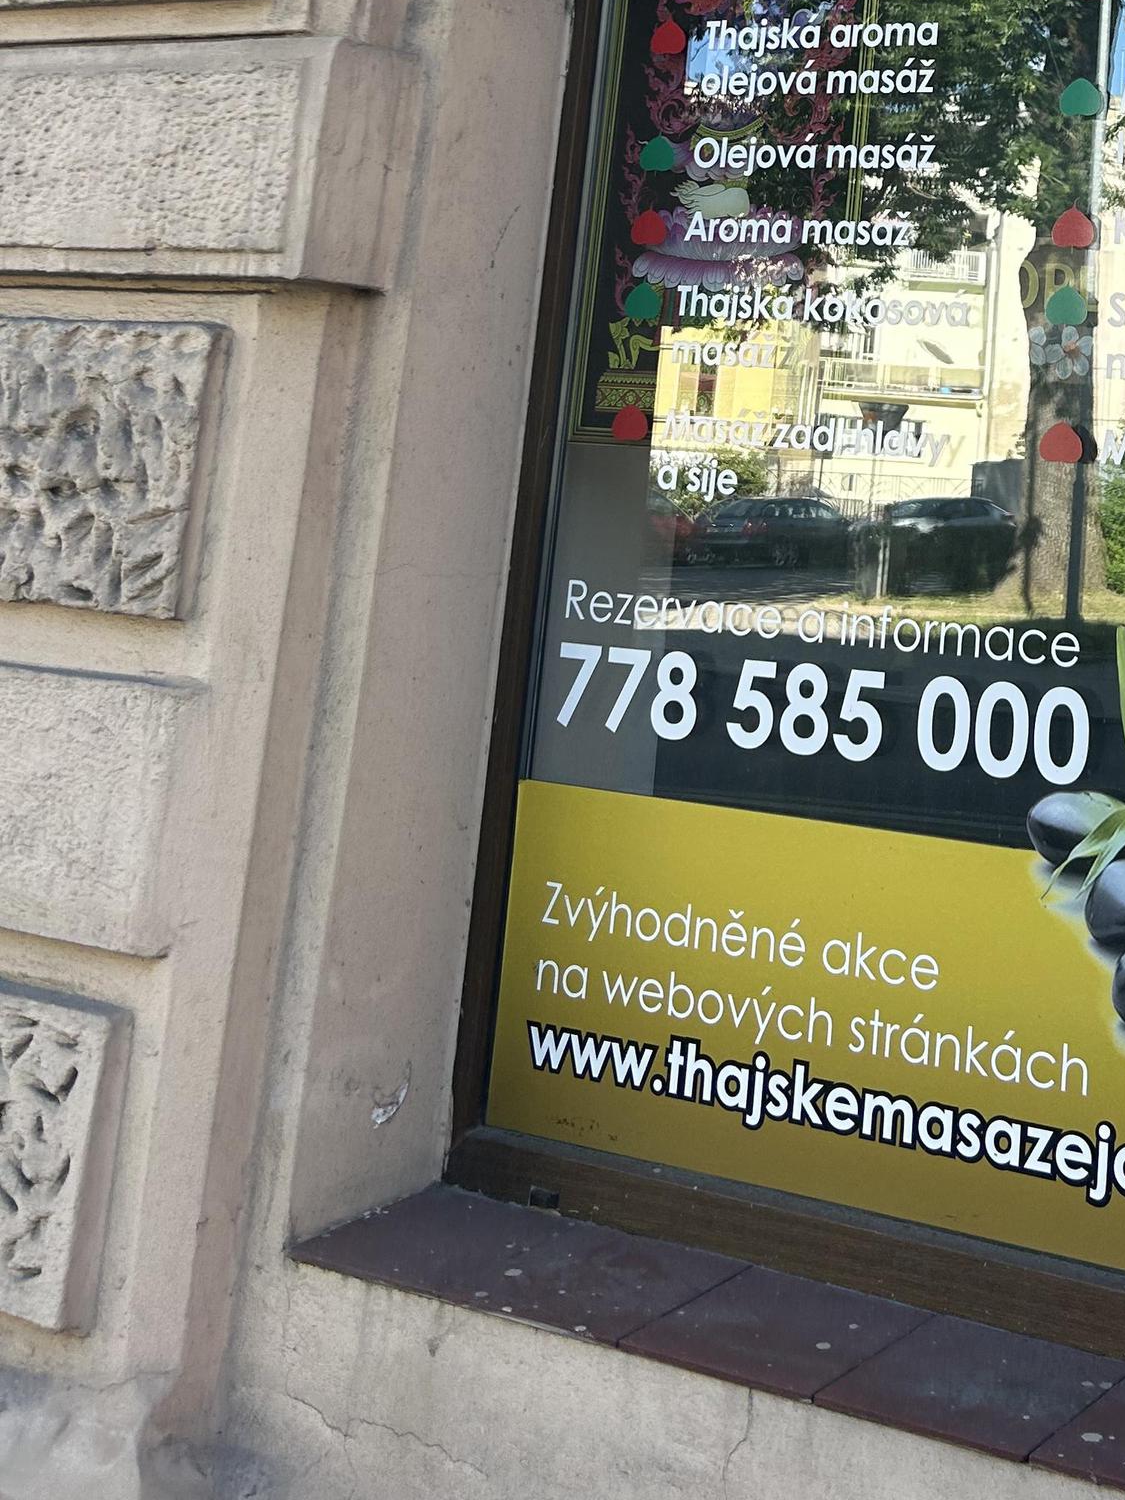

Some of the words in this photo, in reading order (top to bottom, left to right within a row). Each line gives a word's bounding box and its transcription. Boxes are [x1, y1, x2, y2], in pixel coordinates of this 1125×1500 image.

[706, 12, 820, 53] Thajská
[830, 20, 939, 48] aroma
[701, 60, 817, 102] olejová
[826, 59, 936, 94] masáž
[693, 134, 817, 176] Olejová
[826, 134, 936, 170] masáž
[684, 211, 792, 245] Aroma
[801, 211, 912, 247] masáž
[677, 283, 793, 326] Thajská
[803, 288, 971, 328] kokosová
[657, 464, 679, 491] a
[565, 579, 784, 641] Rezervace
[797, 607, 827, 644] a
[839, 605, 1083, 669] informace
[556, 641, 699, 742] 778
[726, 659, 886, 763] 585
[917, 675, 1091, 787] 000
[541, 880, 807, 969] Zvýhodněné
[822, 932, 941, 991] akce
[535, 958, 590, 1000] na
[602, 971, 835, 1047] webových
[848, 1009, 1091, 1097] stránkách
